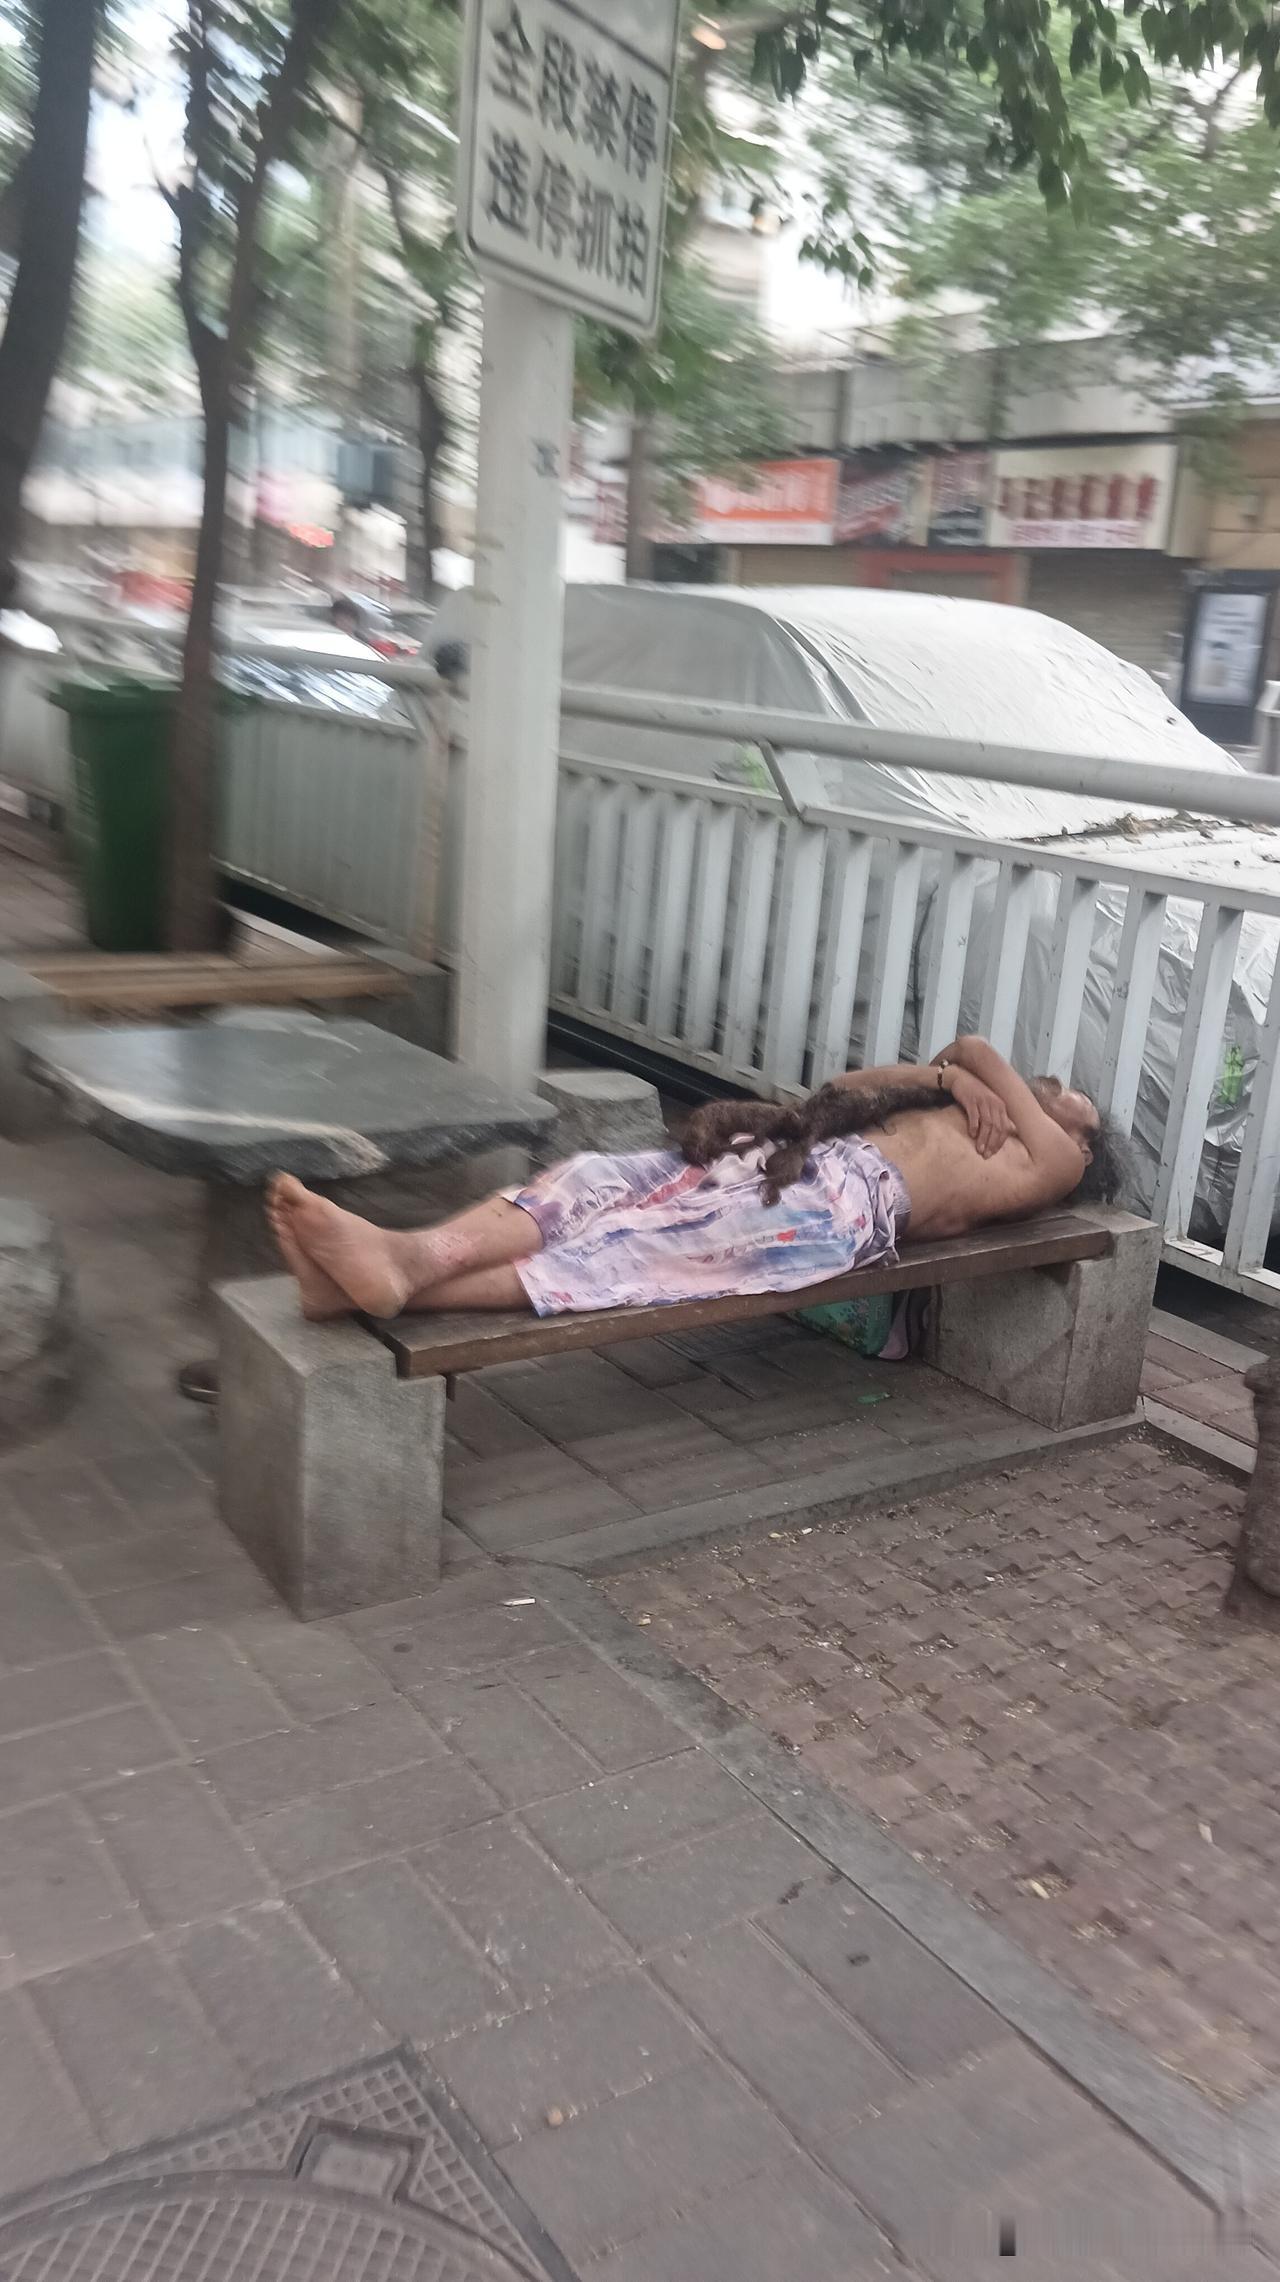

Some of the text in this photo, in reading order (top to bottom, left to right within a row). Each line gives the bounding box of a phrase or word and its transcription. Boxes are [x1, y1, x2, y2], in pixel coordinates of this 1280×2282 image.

[489, 3, 657, 182] 全段禁停
[486, 127, 648, 297] 违停抓拍
